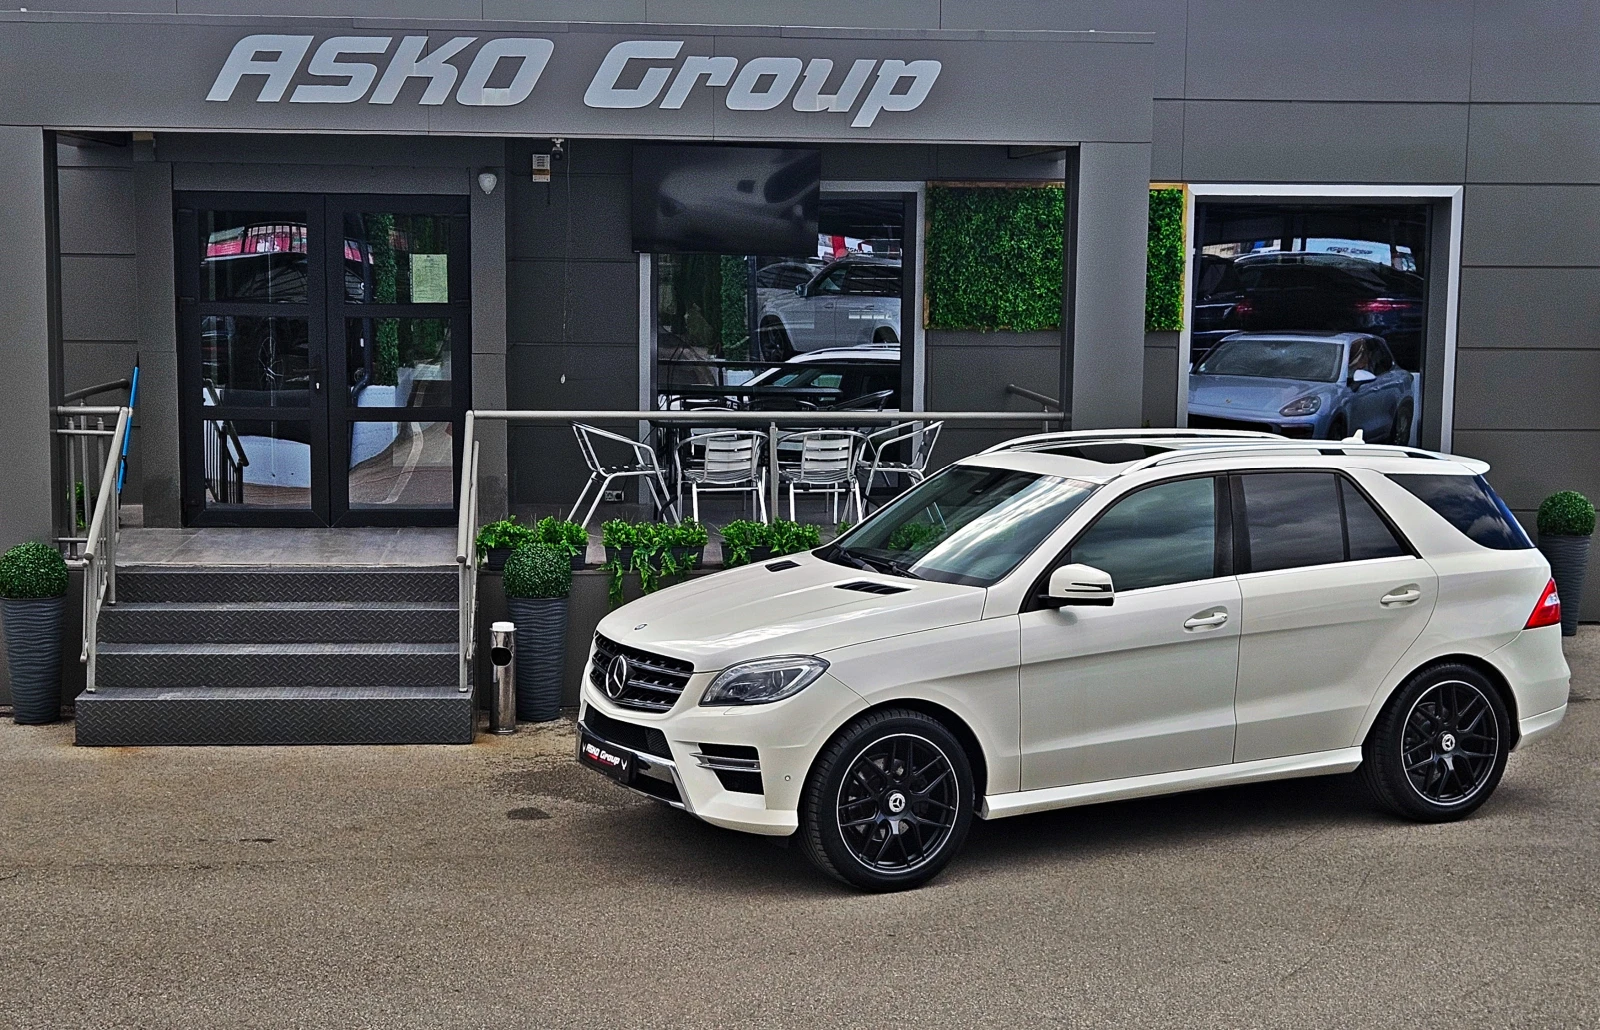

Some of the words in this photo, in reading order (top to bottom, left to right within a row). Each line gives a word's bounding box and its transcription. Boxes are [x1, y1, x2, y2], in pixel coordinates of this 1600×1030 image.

[206, 35, 555, 107] ASKO
[584, 40, 942, 128] Group
[600, 751, 621, 766] Group
